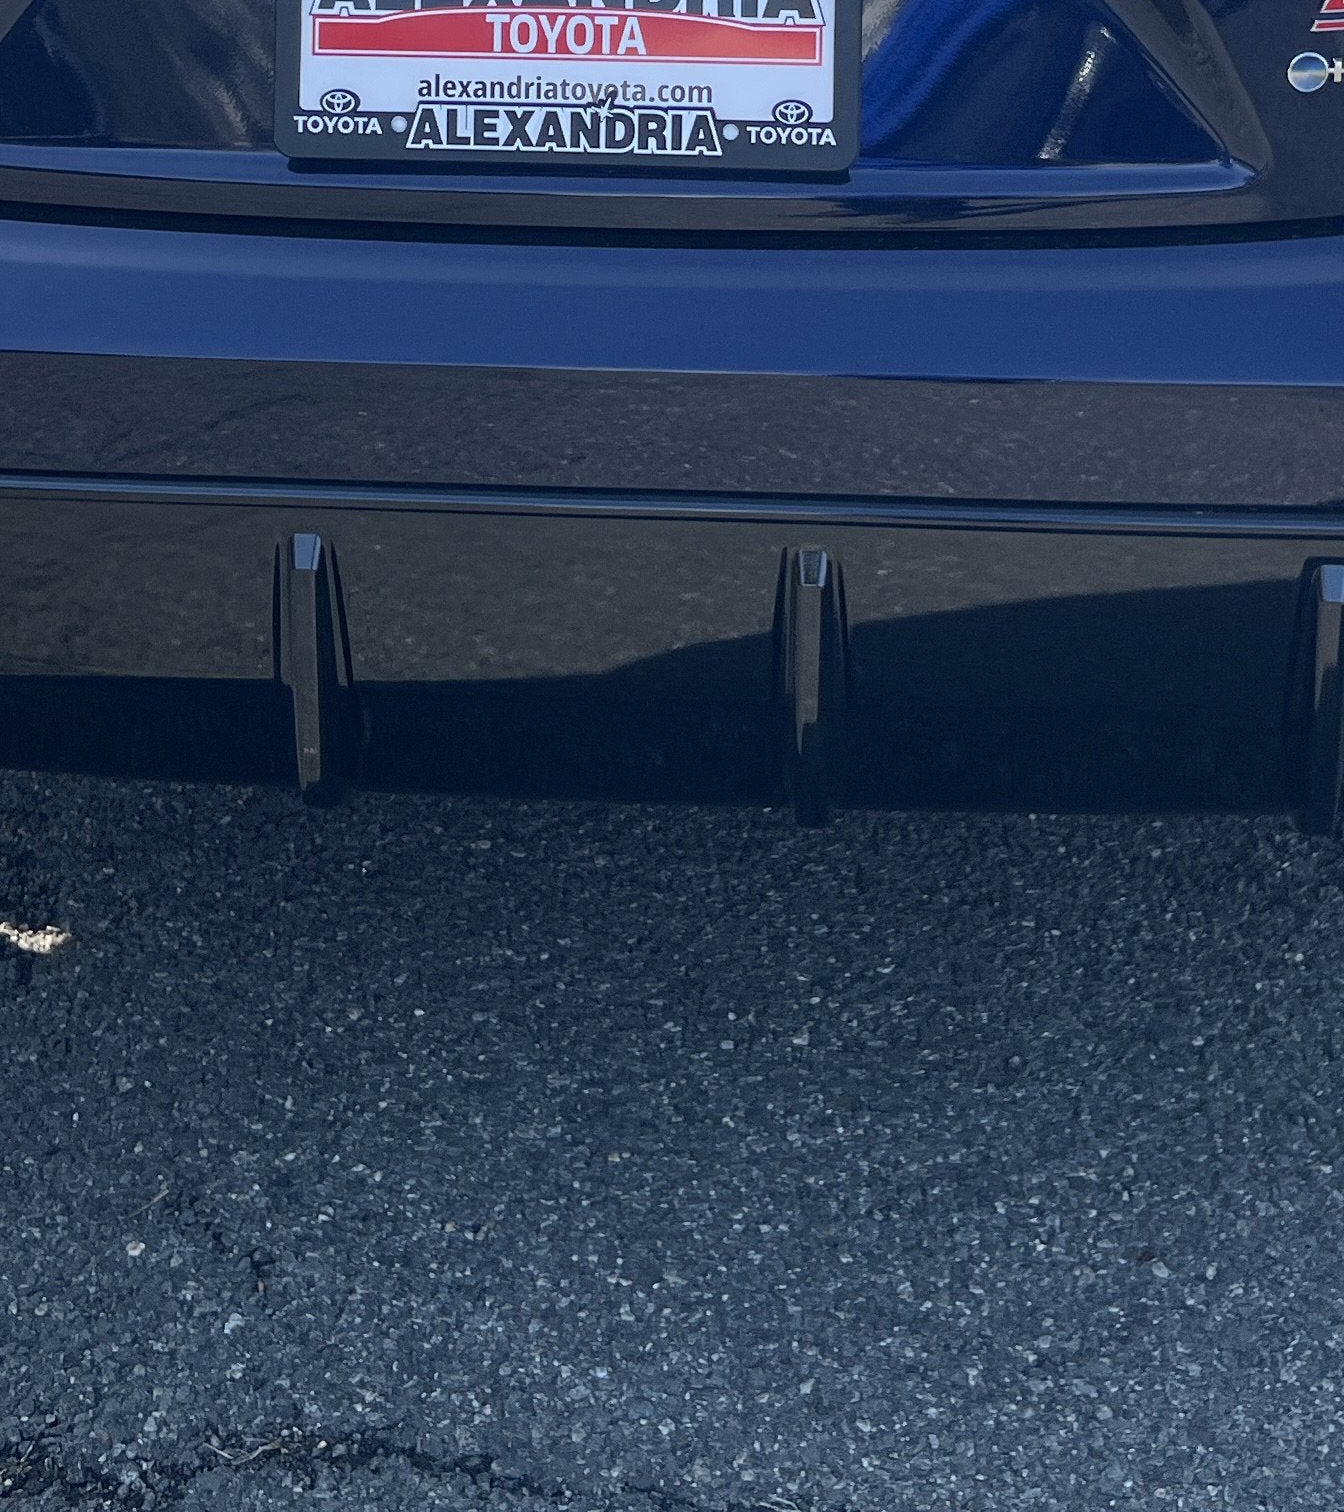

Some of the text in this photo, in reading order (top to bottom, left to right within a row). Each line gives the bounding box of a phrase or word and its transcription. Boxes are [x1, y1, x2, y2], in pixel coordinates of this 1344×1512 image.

[485, 13, 647, 56] TOYOTA
[417, 73, 714, 106] alexandriatoyota.com
[293, 115, 383, 136] TOYOTA
[407, 104, 722, 156] ALEXANDRIA
[745, 125, 838, 148] TOYOTA
